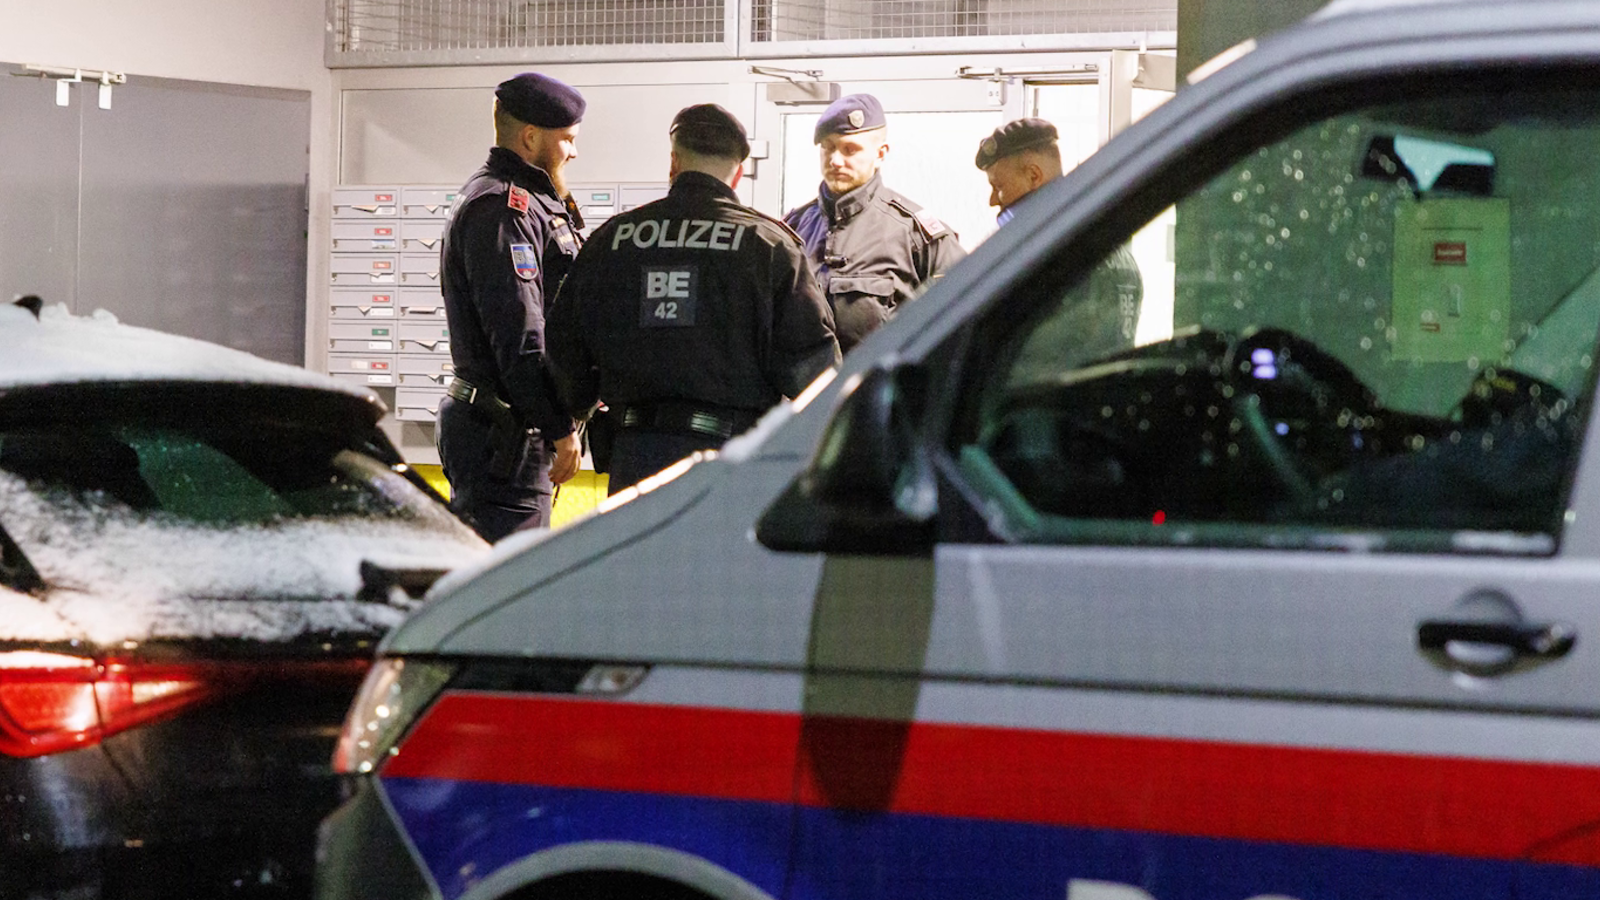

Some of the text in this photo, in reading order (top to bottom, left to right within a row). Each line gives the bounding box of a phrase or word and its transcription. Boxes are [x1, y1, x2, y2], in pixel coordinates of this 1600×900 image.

[611, 219, 745, 250] POLIZEI
[647, 271, 691, 299] BE
[654, 302, 678, 320] 42
